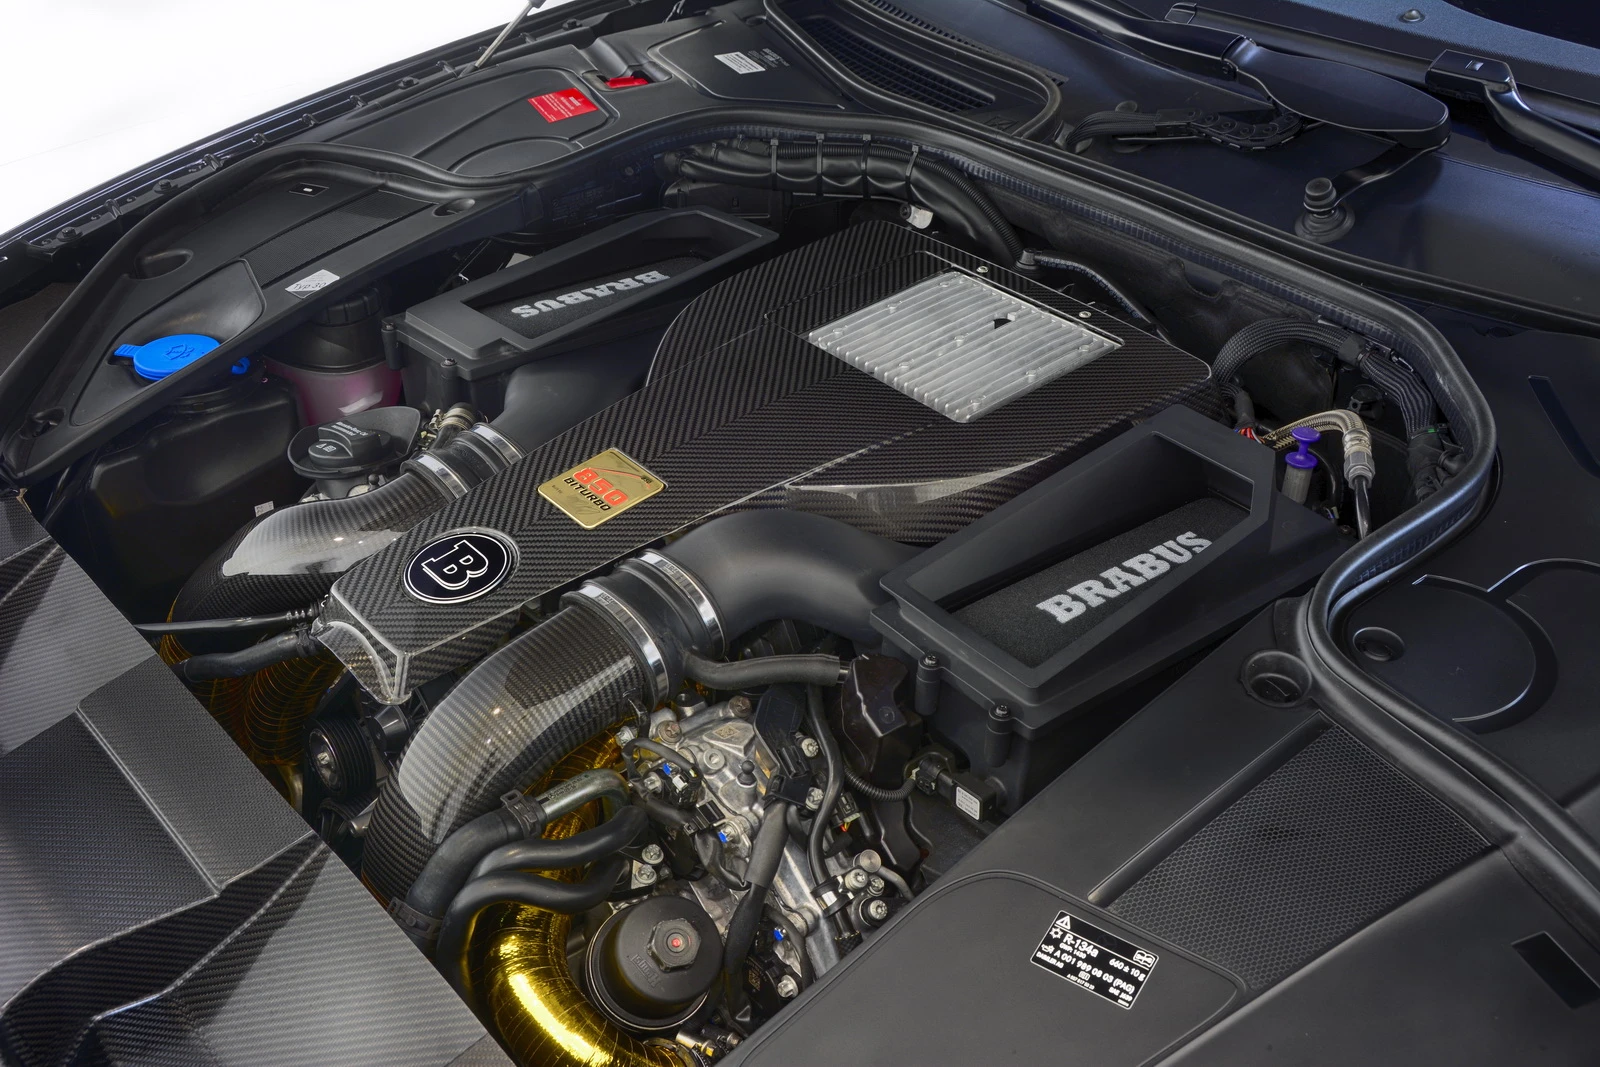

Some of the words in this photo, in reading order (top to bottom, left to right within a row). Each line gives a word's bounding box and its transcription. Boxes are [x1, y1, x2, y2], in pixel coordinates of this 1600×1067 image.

[511, 270, 671, 318] BRABUS
[563, 477, 611, 511] BITURBO
[573, 468, 628, 506] 850
[421, 540, 489, 591] B
[1036, 531, 1213, 624] BRABUS
[1054, 950, 1060, 958] A
[1061, 953, 1076, 964] 001
[1077, 960, 1092, 972] 989
[1102, 973, 1114, 983] 03
[1113, 978, 1135, 994] (PAG)
[1063, 933, 1098, 957] R-134a
[1109, 958, 1124, 969] 660
[1130, 968, 1140, 977] 10
